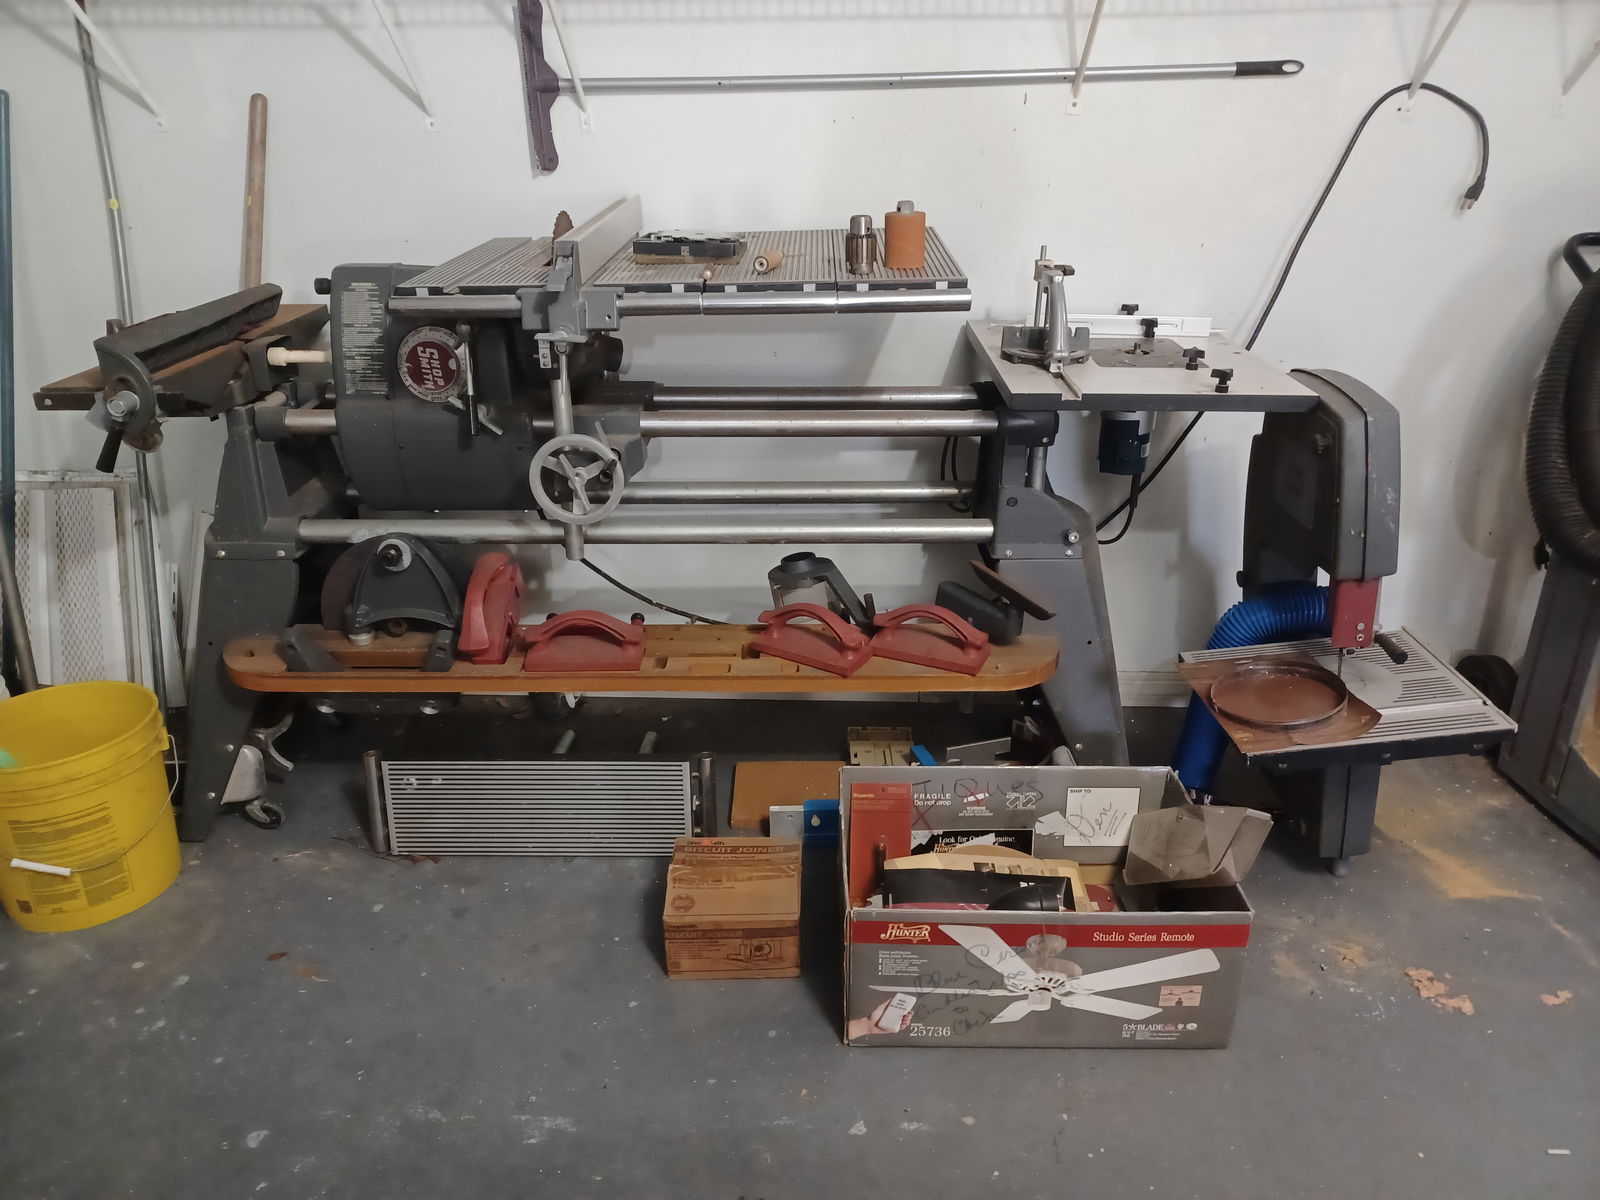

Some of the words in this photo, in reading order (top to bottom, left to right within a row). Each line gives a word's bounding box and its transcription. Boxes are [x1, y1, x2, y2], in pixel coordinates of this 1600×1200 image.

[417, 346, 435, 389] SMITH
[425, 347, 445, 386] SHOP
[957, 835, 968, 843] for
[880, 923, 932, 943] HUNTER
[1093, 932, 1125, 942] Studio
[1128, 932, 1157, 942] Series
[1160, 932, 1195, 942] Remote
[910, 1026, 951, 1037] 25736
